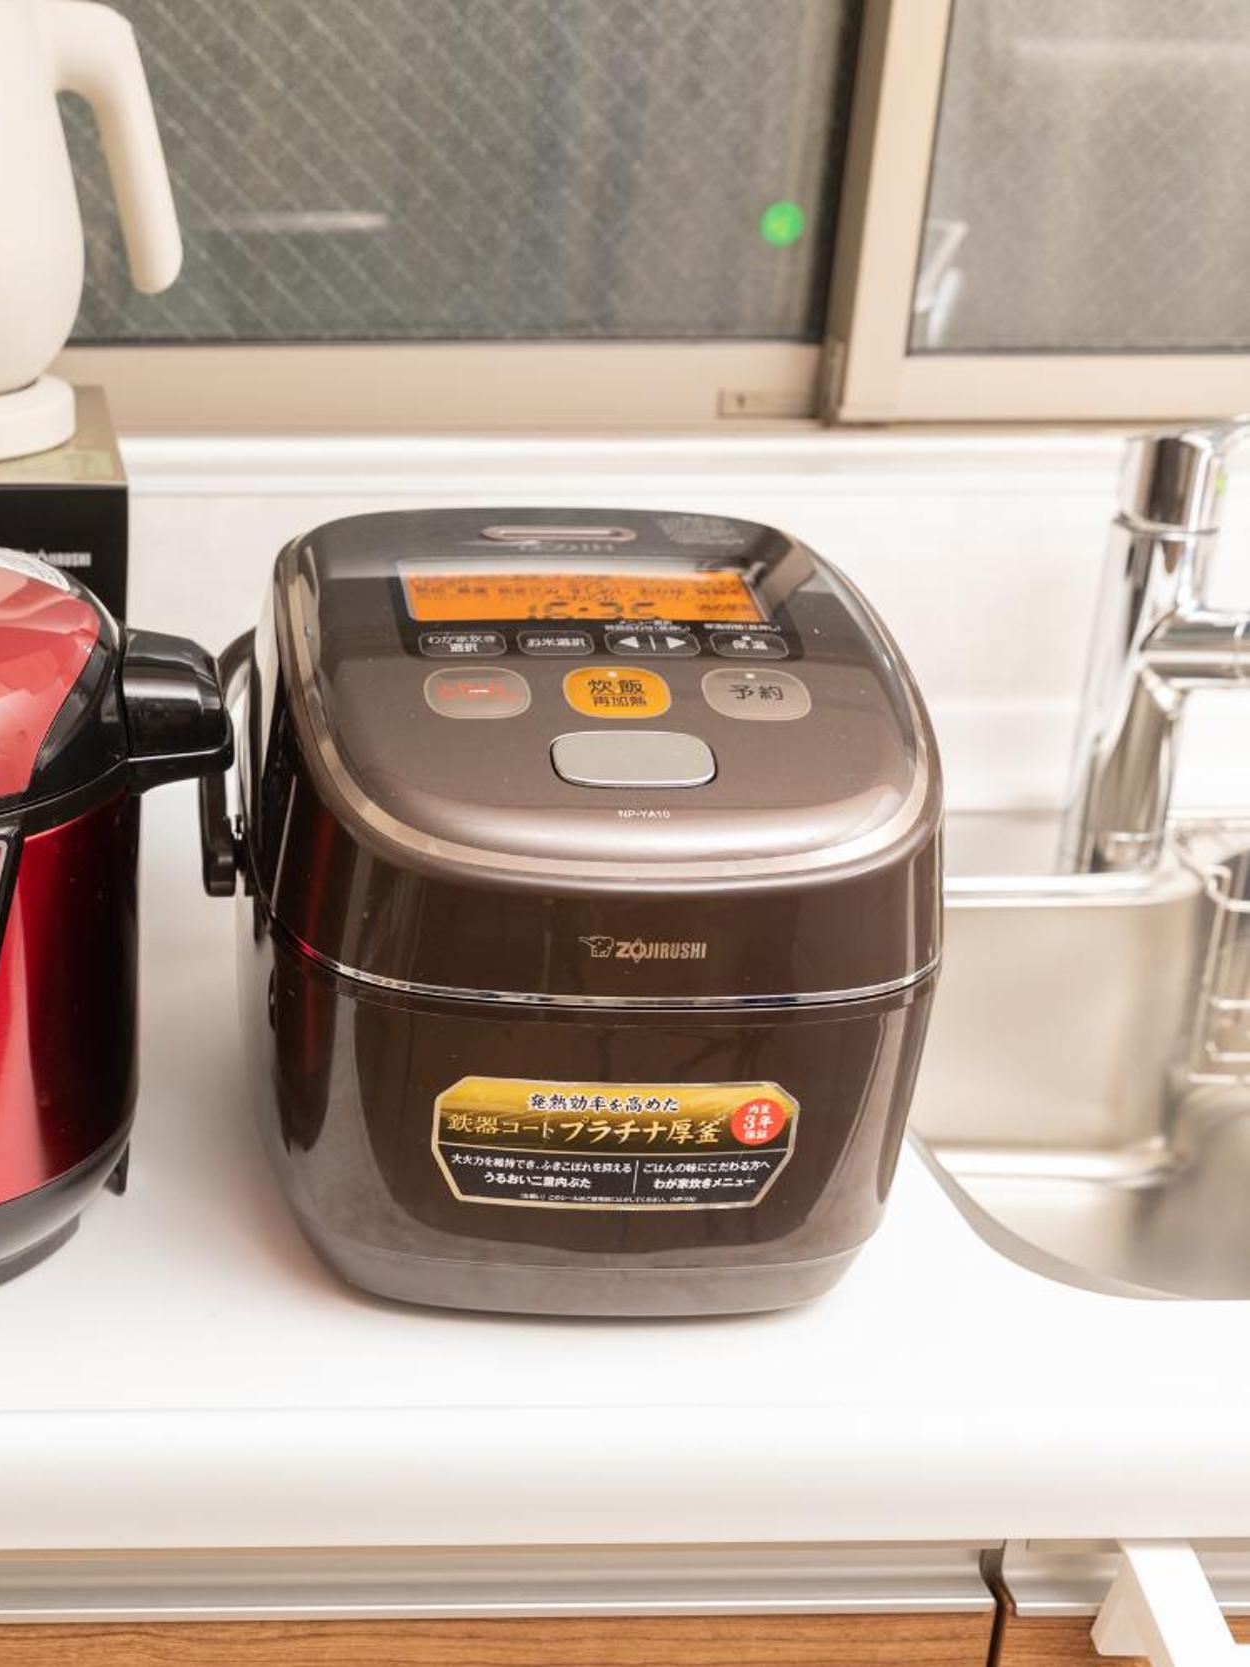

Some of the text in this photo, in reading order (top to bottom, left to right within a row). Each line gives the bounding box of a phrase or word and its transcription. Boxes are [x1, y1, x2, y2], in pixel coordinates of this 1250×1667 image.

[588, 679, 645, 695] 炊飯
[729, 684, 784, 701] 予約
[615, 938, 708, 964] ZOJIRUSHI
[528, 1094, 680, 1113] 発熱効率を高めた
